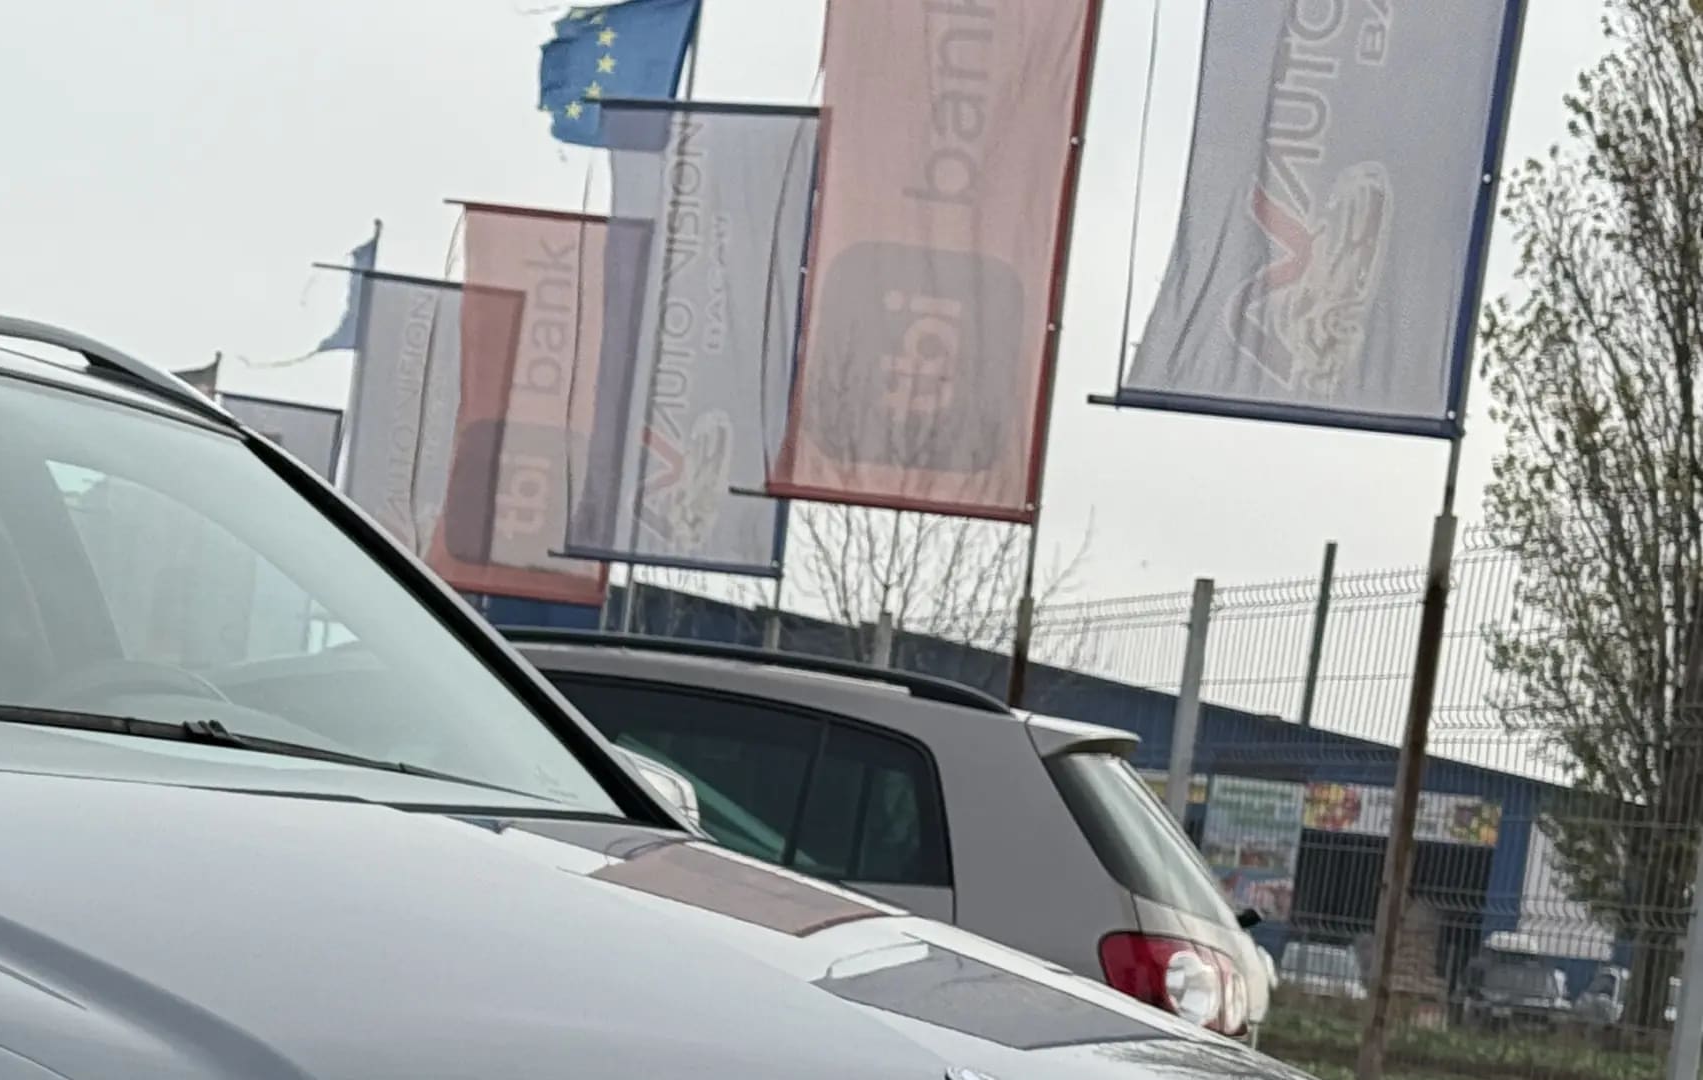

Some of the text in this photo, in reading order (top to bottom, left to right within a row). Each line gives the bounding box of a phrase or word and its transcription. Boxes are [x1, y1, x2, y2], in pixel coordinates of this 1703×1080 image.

[499, 237, 577, 539] tbi bank
[653, 118, 705, 440] AUTO VISION
[881, 289, 962, 422] tbi
